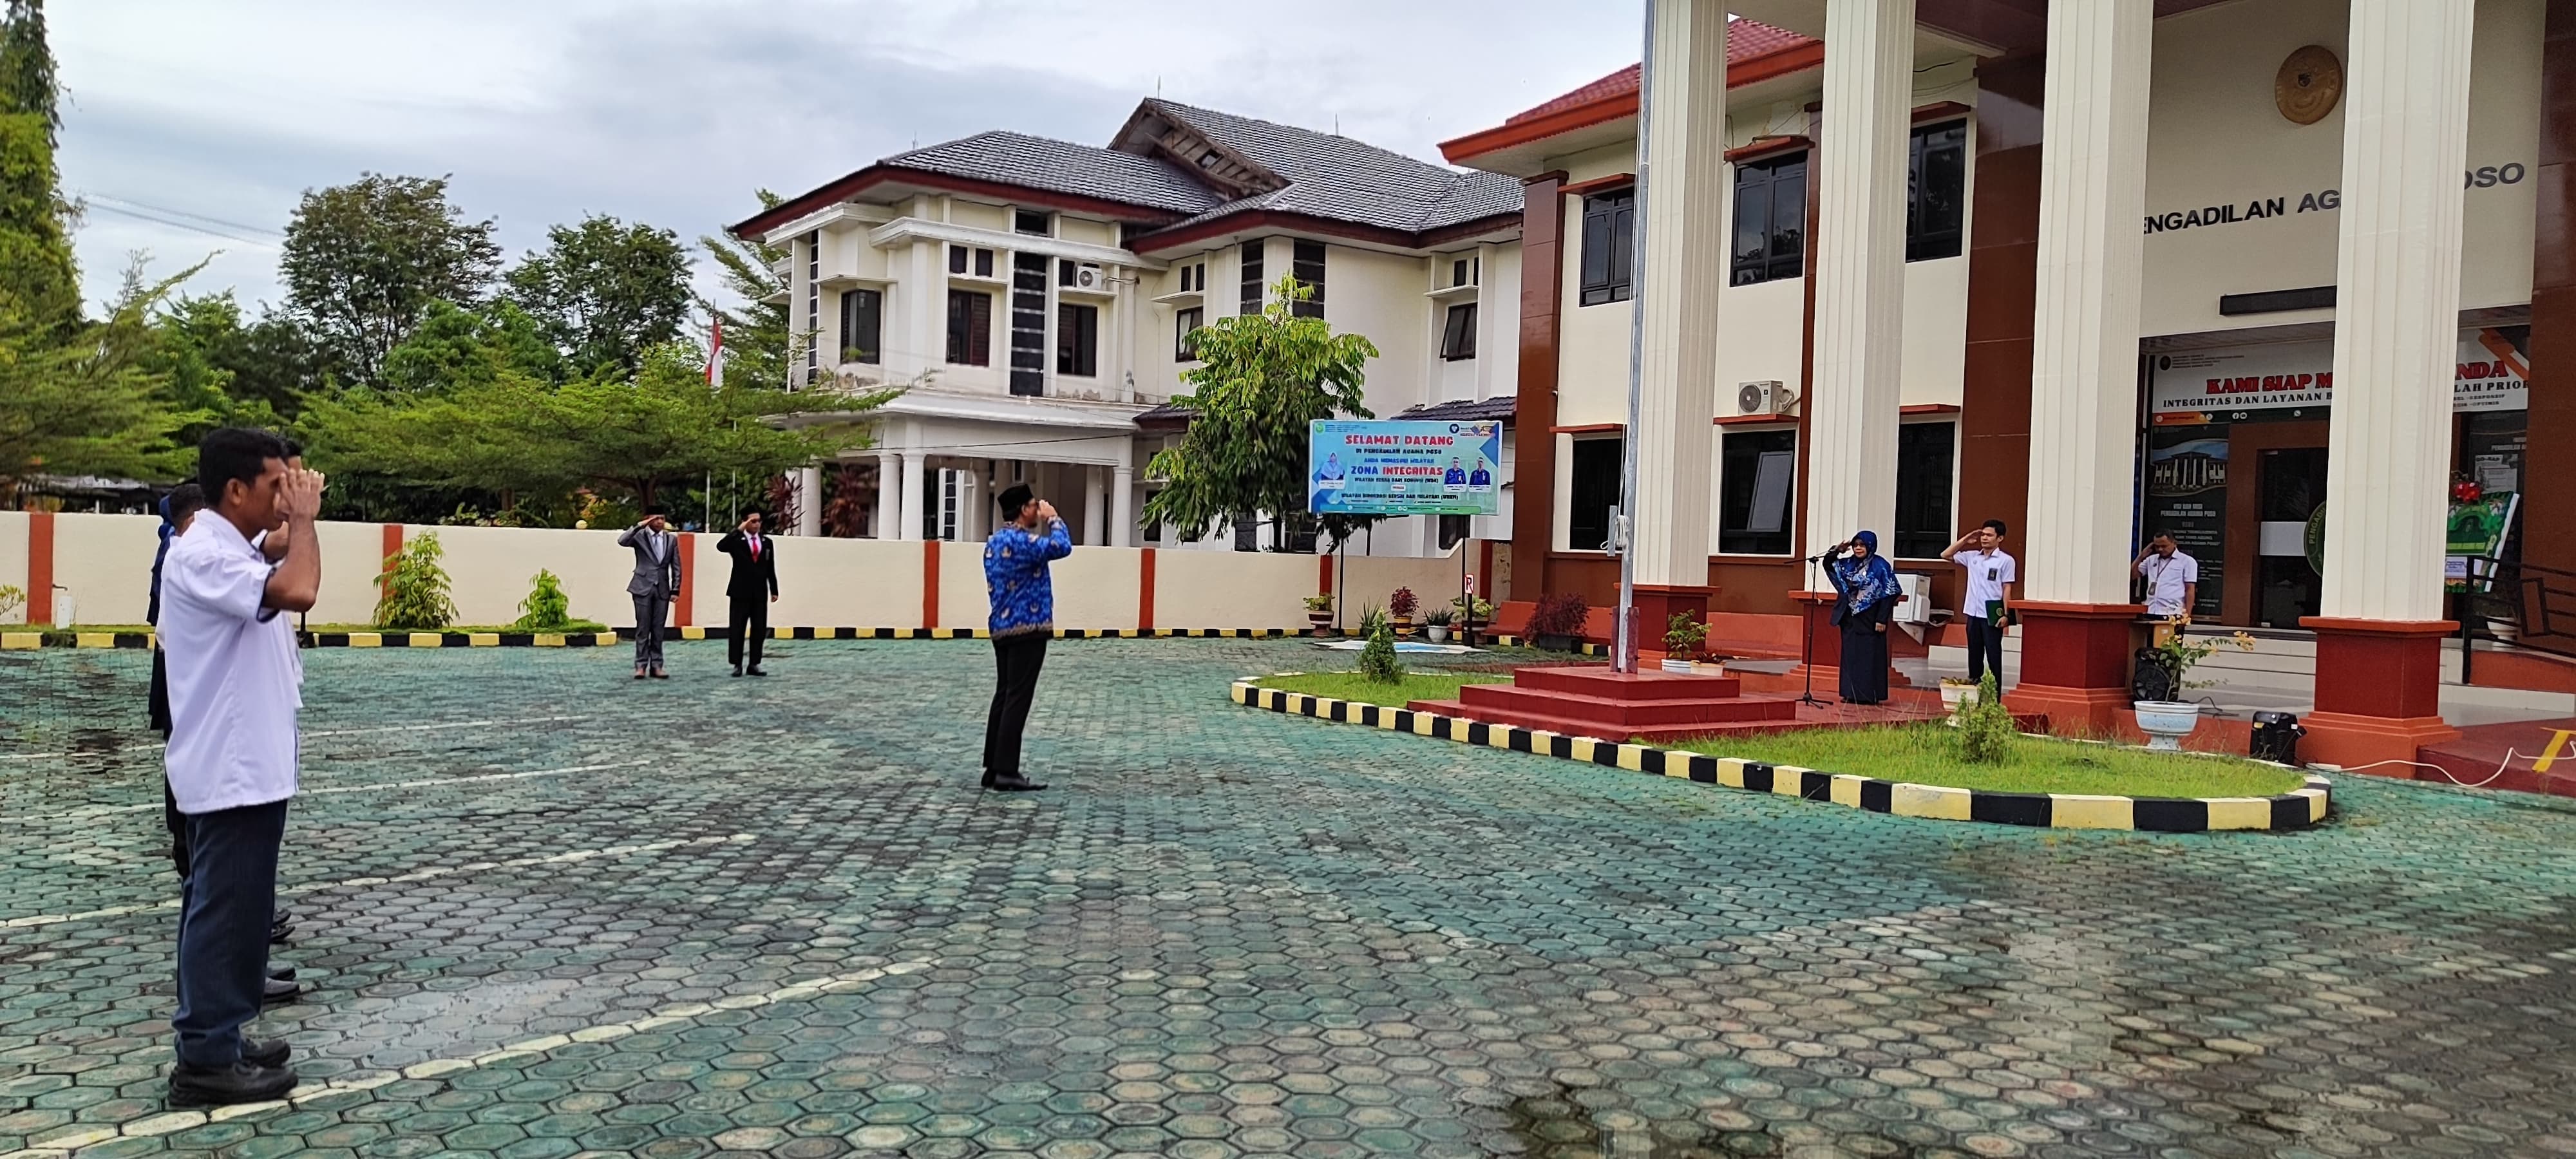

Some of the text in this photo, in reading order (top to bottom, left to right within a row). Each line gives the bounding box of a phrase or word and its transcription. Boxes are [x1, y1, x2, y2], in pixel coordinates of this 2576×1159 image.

[2297, 190, 2340, 213] AG
[2206, 377, 2260, 394] KAMI
[2262, 373, 2312, 391] SIAP
[2455, 361, 2509, 381] NDA
[2163, 399, 2231, 408] INTEGRITAS
[2235, 396, 2259, 404] DAN
[2262, 393, 2322, 403] LAYANAN
[2454, 383, 2481, 392] LAH
[1345, 435, 1454, 446] SELAMAT DATANG
[1350, 466, 1443, 475] ZONA INTEGRITAS
